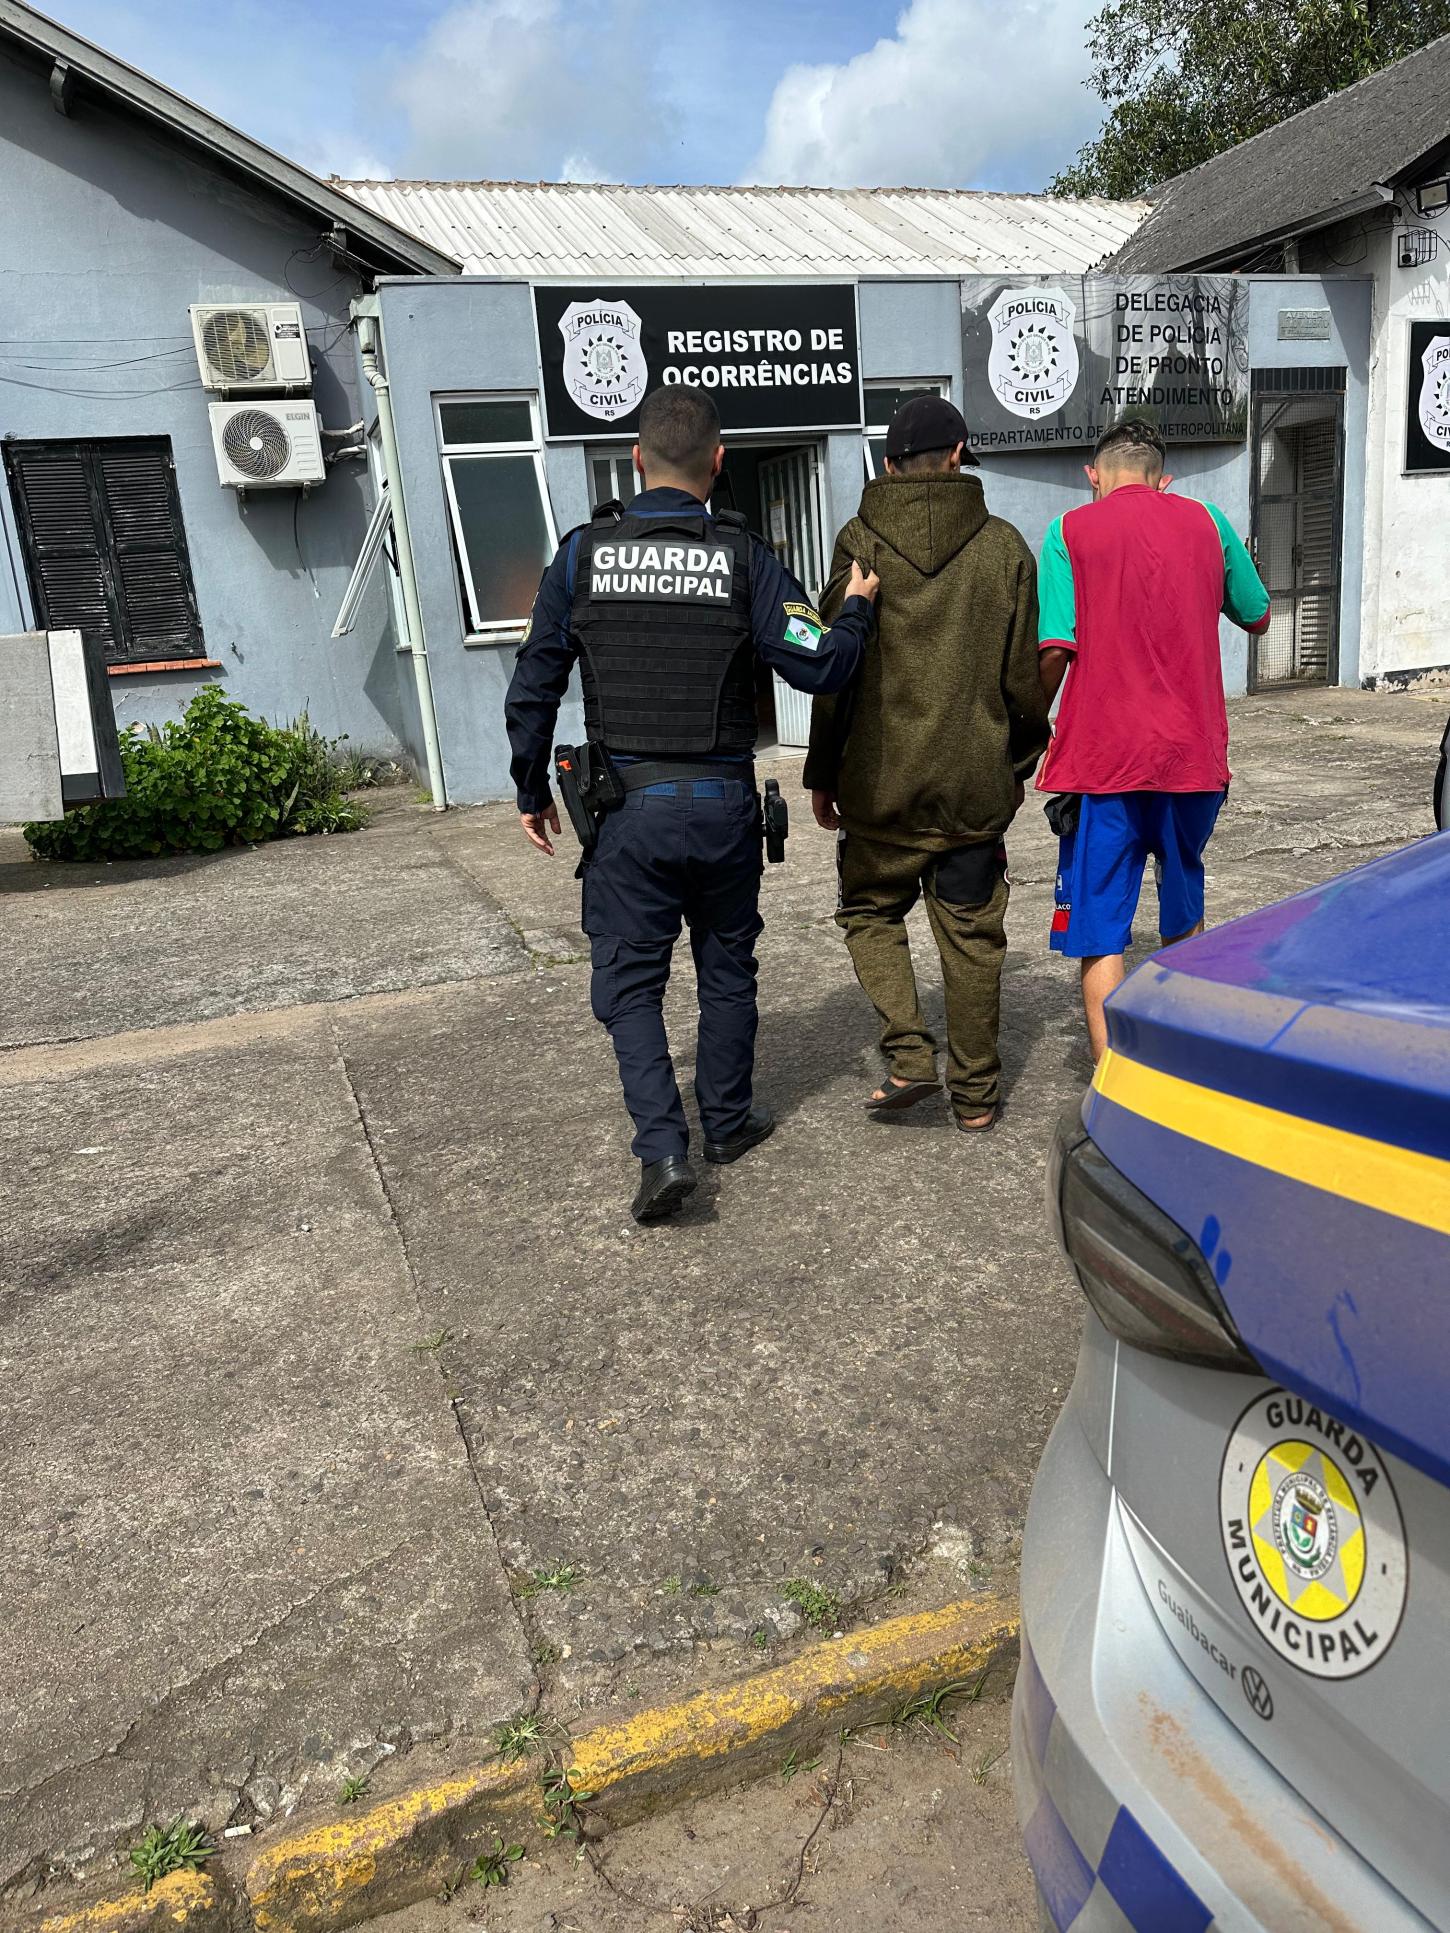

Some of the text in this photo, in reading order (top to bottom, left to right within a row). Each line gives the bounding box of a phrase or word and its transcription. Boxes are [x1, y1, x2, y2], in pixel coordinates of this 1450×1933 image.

[1008, 298, 1057, 318] POLÍCIA
[1116, 293, 1221, 314] DELEGACIA
[577, 311, 623, 328] POLÍCIA
[667, 328, 844, 353] REGISTRO DE
[1117, 321, 1221, 345] DE POLÍCIA
[662, 360, 852, 388] OCORRÊNCIAS
[1116, 356, 1223, 375] DE PRONTO
[590, 393, 627, 406] CIVIL
[1014, 390, 1055, 403] CIVIL
[1100, 387, 1232, 406] ATENDIMENTO
[286, 413, 310, 421] ELGIN
[1029, 407, 1041, 415] RS
[970, 426, 1082, 447] DEPARTAMENTO
[1158, 422, 1244, 437] METROPOLITANA
[593, 546, 730, 575] GUARDA
[592, 574, 729, 599] MUNICIPAL
[1266, 1398, 1379, 1496] GUARDA
[1228, 1519, 1379, 1663] MUNICIPAL
[1157, 1579, 1237, 1681] Guaibacar
